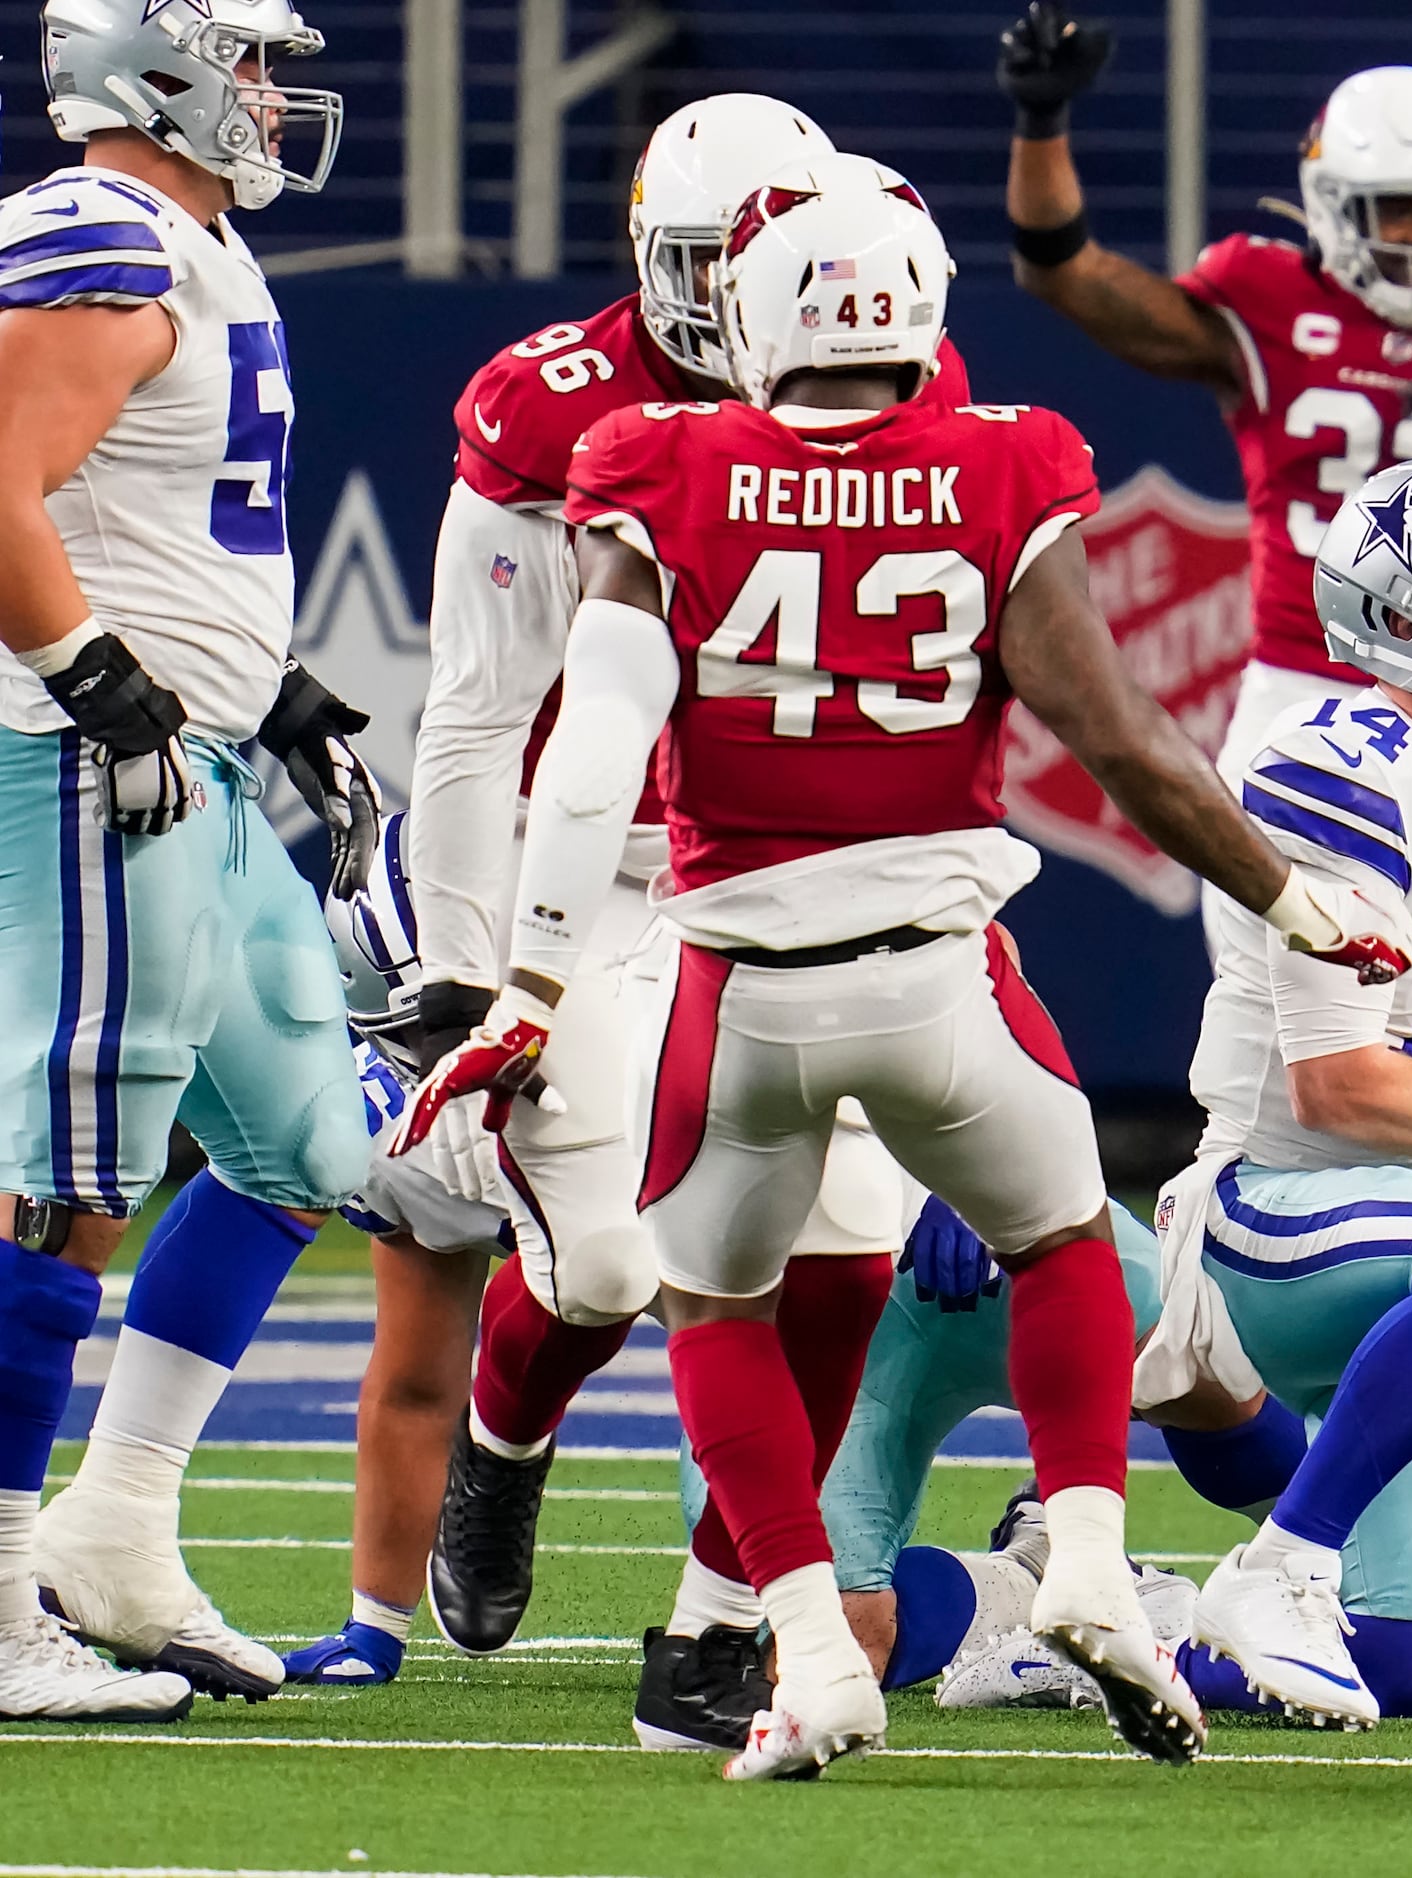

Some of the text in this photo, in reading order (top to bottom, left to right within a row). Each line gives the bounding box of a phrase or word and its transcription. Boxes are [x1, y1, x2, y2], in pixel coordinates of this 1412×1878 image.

[511, 324, 615, 394] 96
[1292, 311, 1343, 357] C
[209, 320, 294, 556] 5
[727, 463, 963, 529] REDDICK
[697, 549, 988, 739] 43
[1300, 698, 1411, 764] 14
